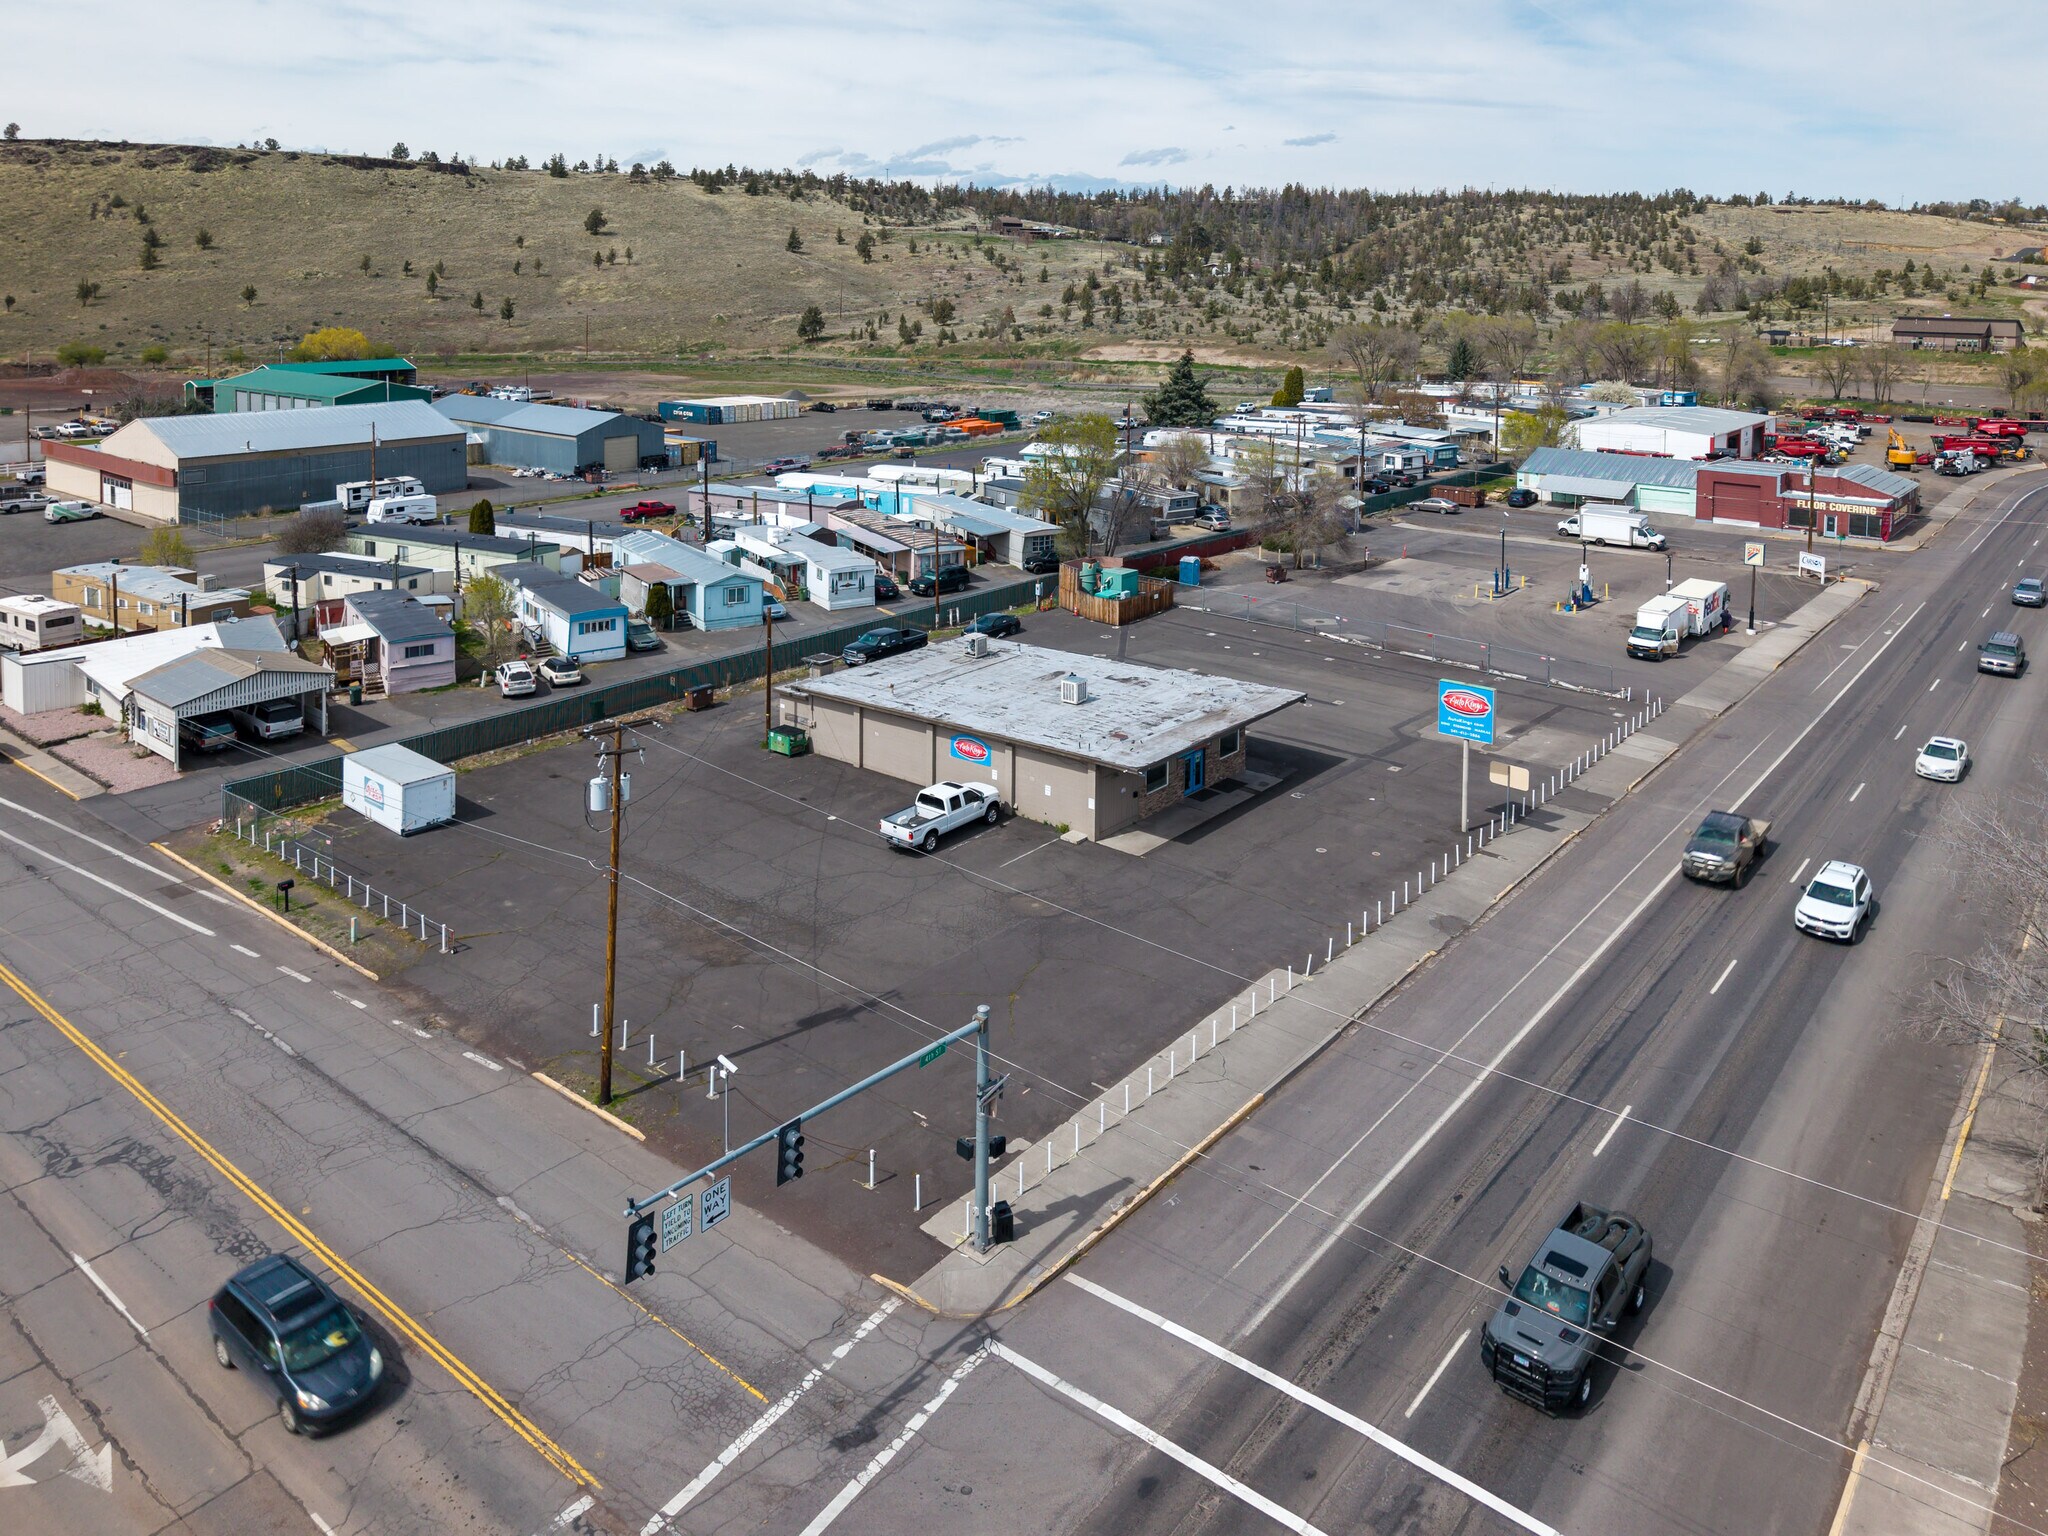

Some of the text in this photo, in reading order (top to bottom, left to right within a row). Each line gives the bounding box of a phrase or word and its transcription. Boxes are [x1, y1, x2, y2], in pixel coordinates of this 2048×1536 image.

[1829, 503, 1877, 515] COVERING
[705, 1182, 726, 1202] ONE
[664, 1199, 692, 1221] LEFT TURN
[704, 1194, 727, 1215] WAY
[664, 1217, 691, 1239] ONCOMING
[665, 1208, 691, 1229] YIELD TO
[665, 1226, 690, 1247] TRAFFIC
